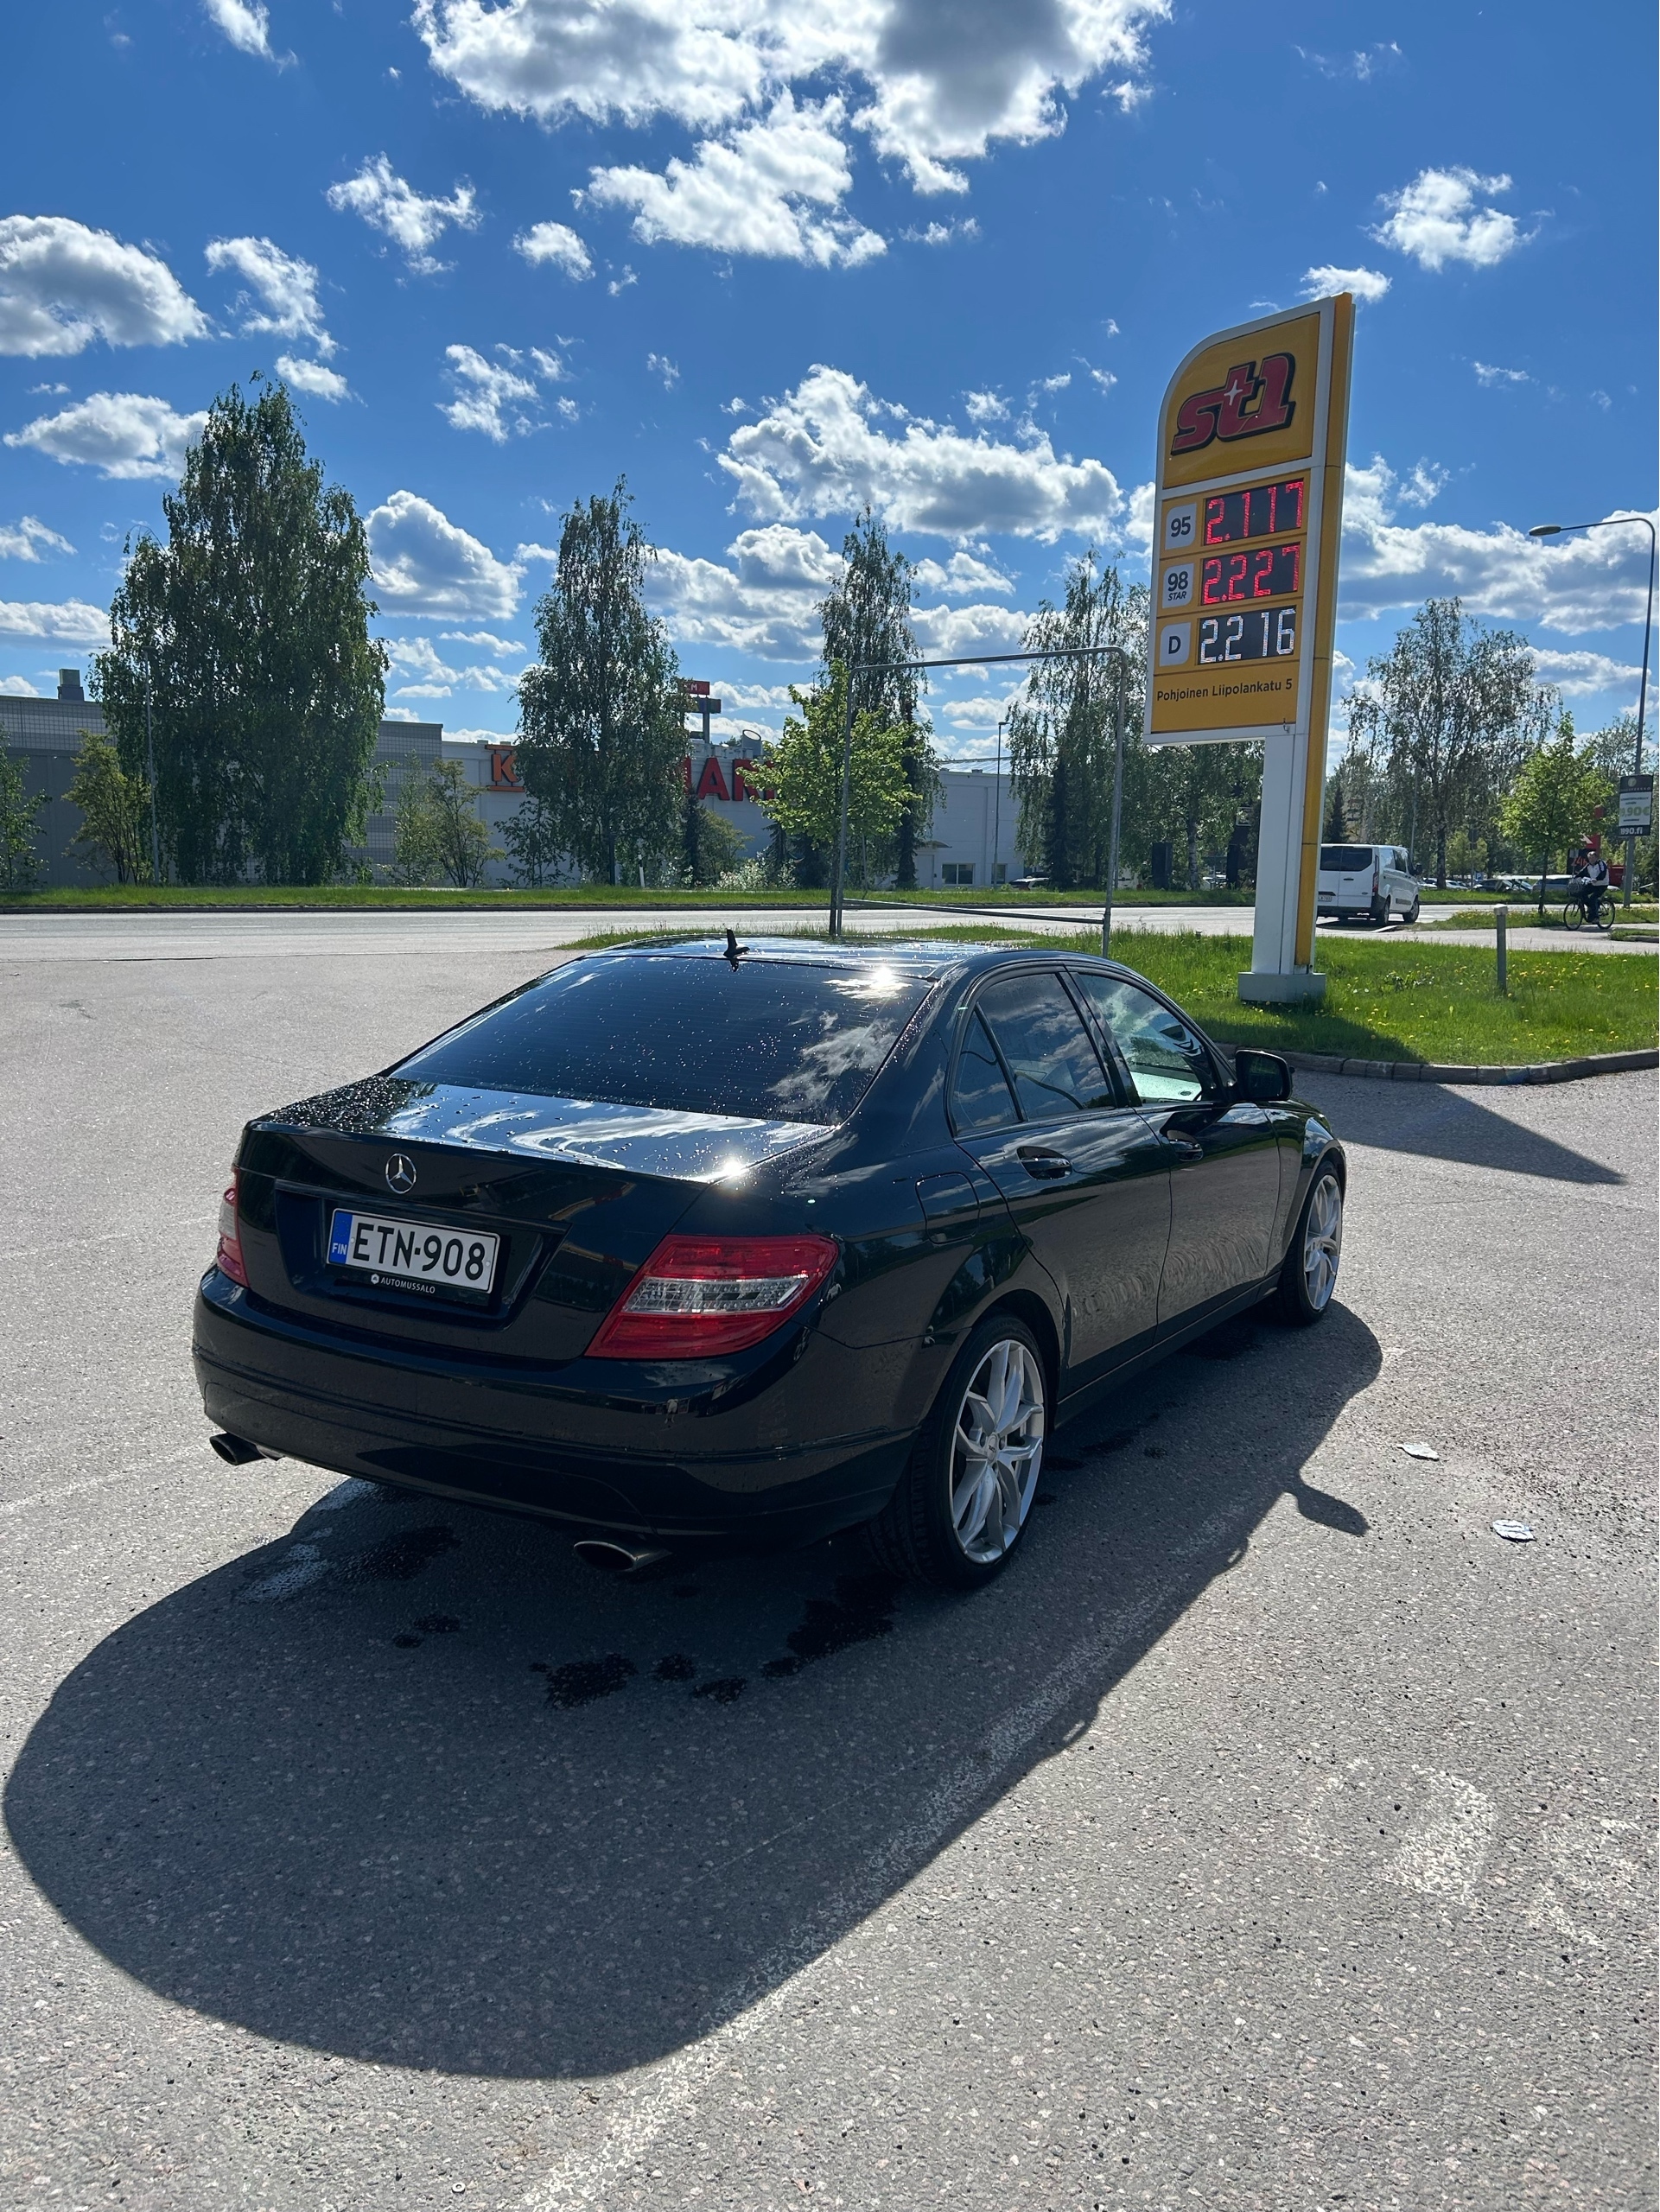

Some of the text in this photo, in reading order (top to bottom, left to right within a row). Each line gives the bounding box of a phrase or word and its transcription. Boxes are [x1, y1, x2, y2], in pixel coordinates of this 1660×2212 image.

[1205, 480, 1305, 544] 2.117
[1171, 516, 1191, 537] 95
[1167, 570, 1188, 592] 98
[1203, 544, 1301, 605] 2.227
[1167, 591, 1186, 601] STAR
[1168, 635, 1181, 654] D
[1199, 608, 1296, 664] 2.216
[1156, 678, 1293, 702] Pohjoinen Liipolankatu 5
[332, 1243, 347, 1255] FIN
[353, 1222, 486, 1281] ETN-908
[380, 1277, 436, 1294] AUTOMUSSALO
